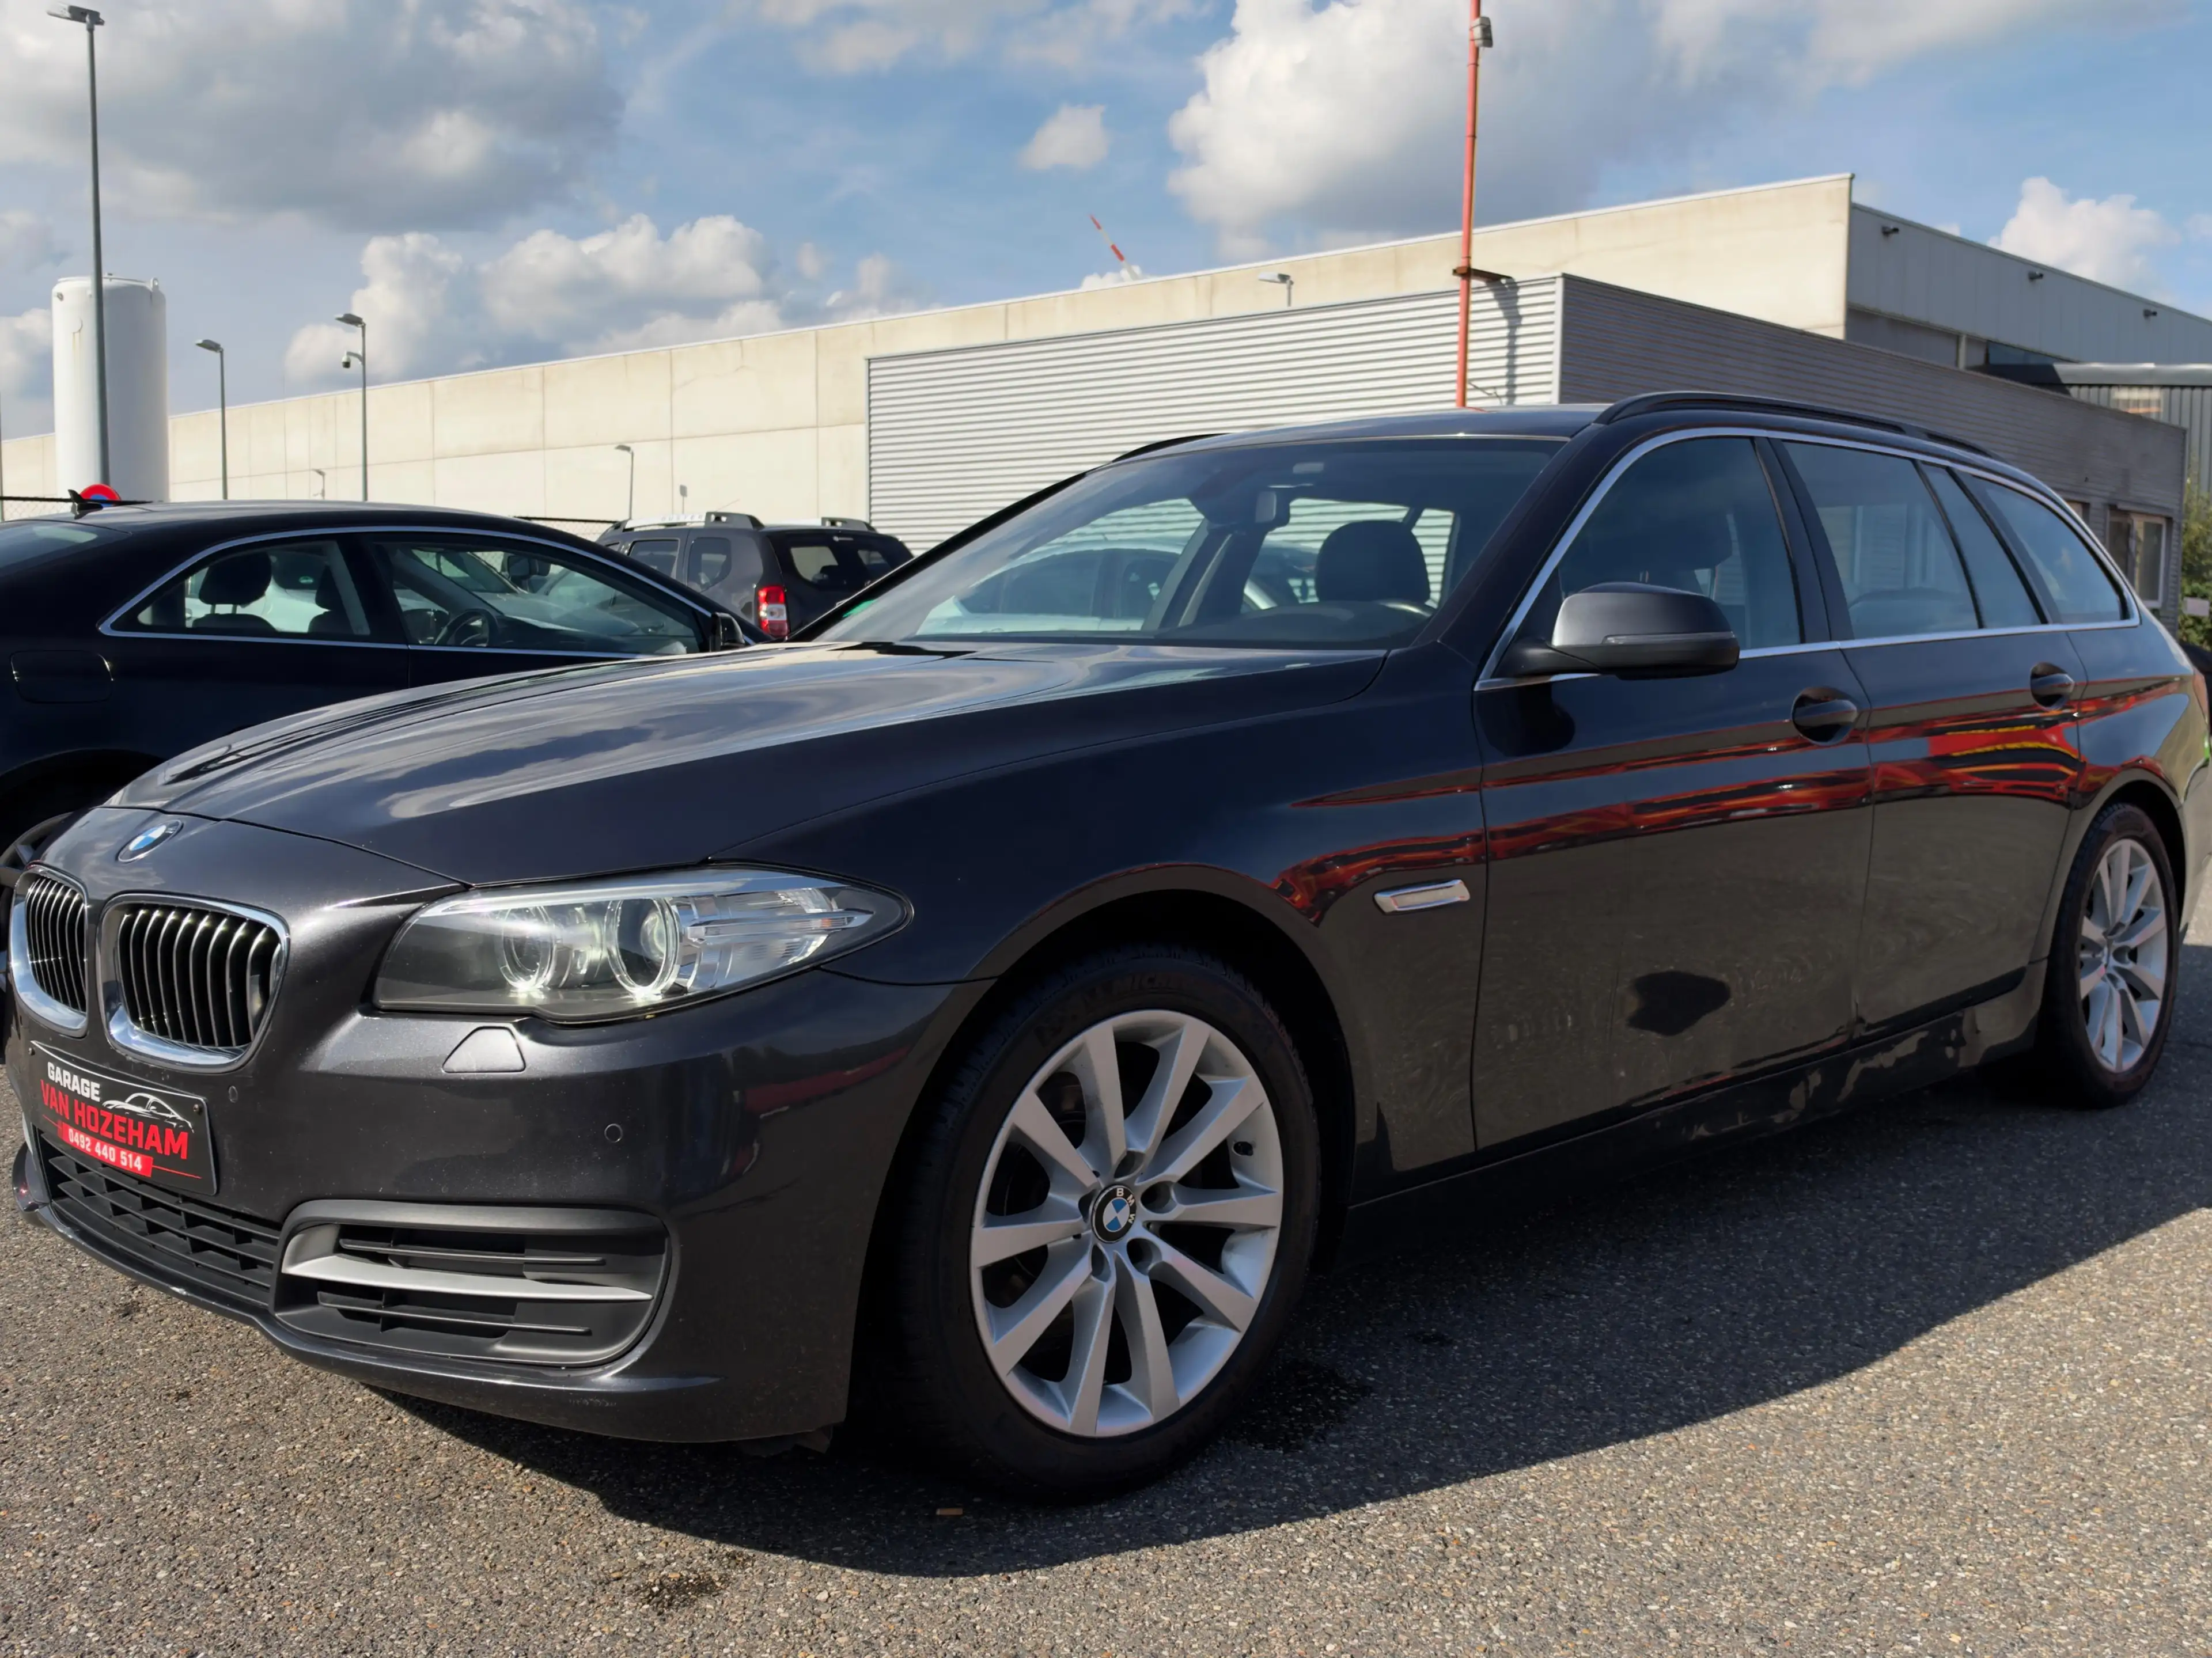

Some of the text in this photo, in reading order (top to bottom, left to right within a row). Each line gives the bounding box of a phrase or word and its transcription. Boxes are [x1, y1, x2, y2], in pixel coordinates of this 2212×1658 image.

[47, 1062, 100, 1102] GARAGE
[40, 1079, 188, 1159] VAN HOZEHAM
[68, 1128, 142, 1171] 0492 440 514
